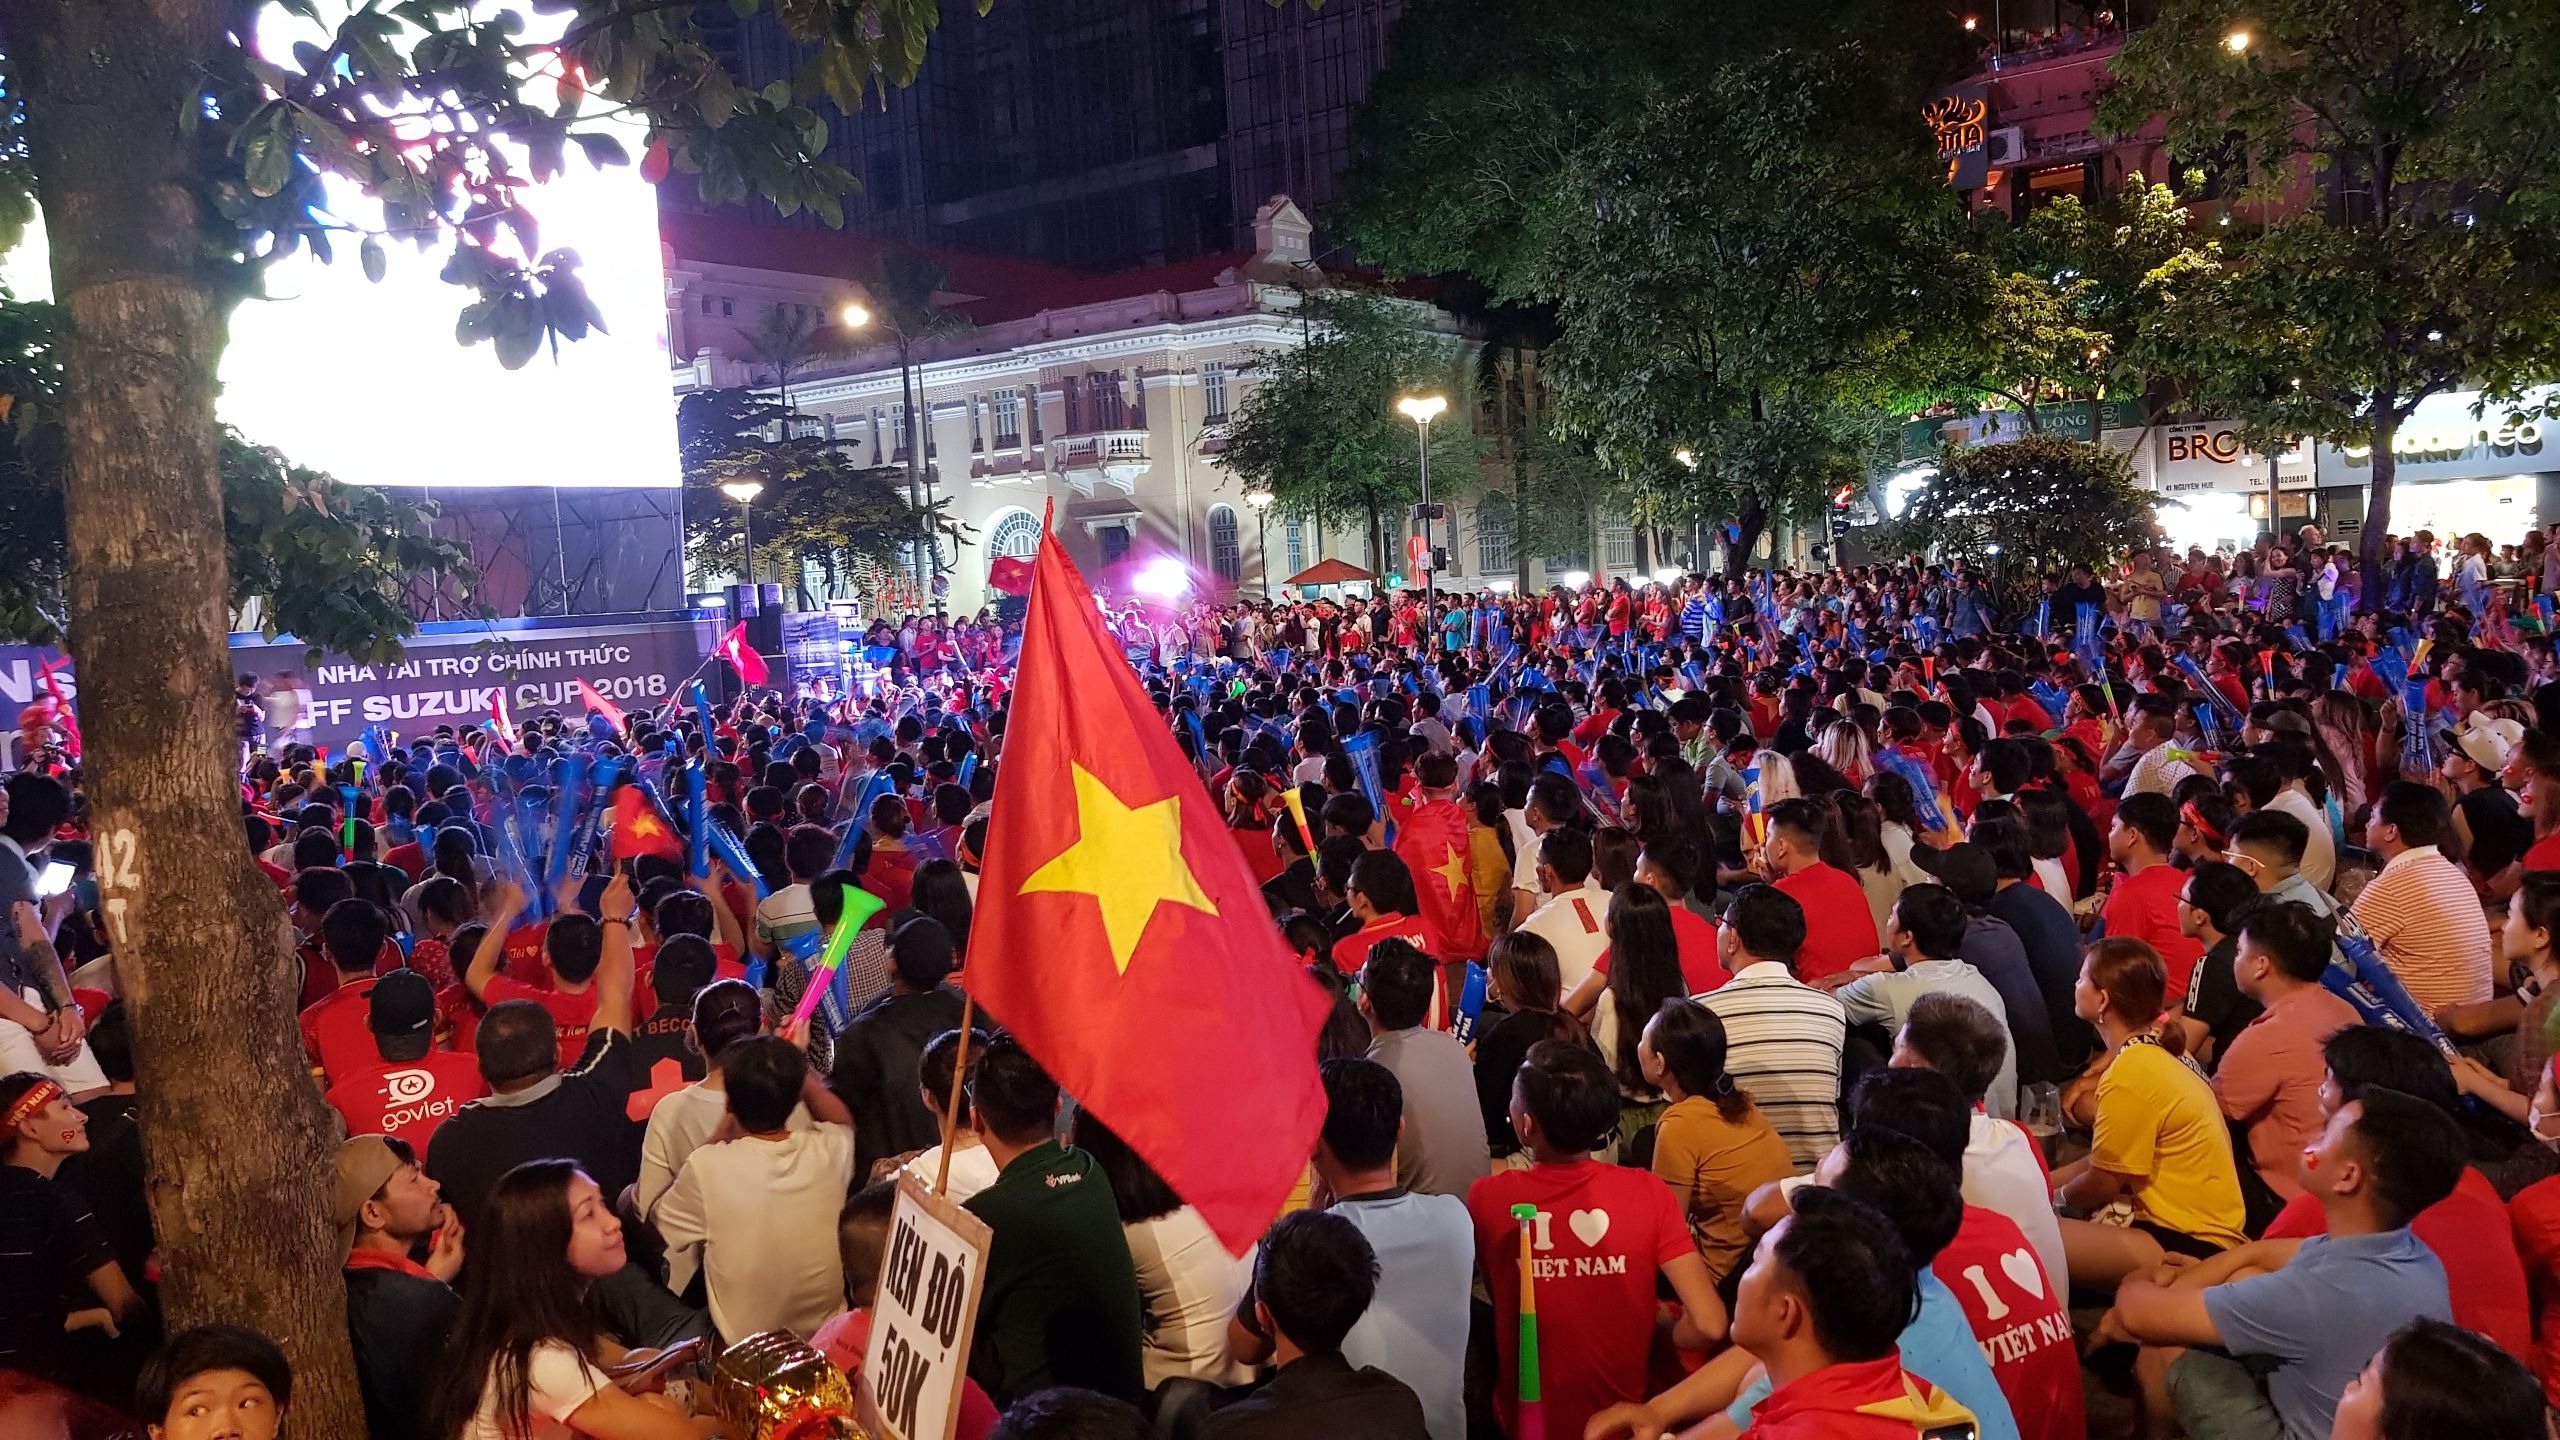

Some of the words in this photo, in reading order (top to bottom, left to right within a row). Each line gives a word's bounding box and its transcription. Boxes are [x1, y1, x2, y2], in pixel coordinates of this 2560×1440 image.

[2043, 415, 2088, 429] LONG
[425, 655, 482, 678] TRỢ
[487, 648, 562, 672] CHÍNH
[565, 643, 631, 666] THỨC
[515, 681, 583, 708] CUP
[593, 673, 667, 701] 2018
[1533, 1211, 1555, 1251] I
[886, 1213, 928, 1318] KÈN
[1574, 1254, 1627, 1277] NAM
[1962, 1264, 2010, 1321] I
[1977, 1323, 2038, 1369] VIỆT
[2036, 1311, 2075, 1347] NA
[876, 1321, 931, 1440] 50K
